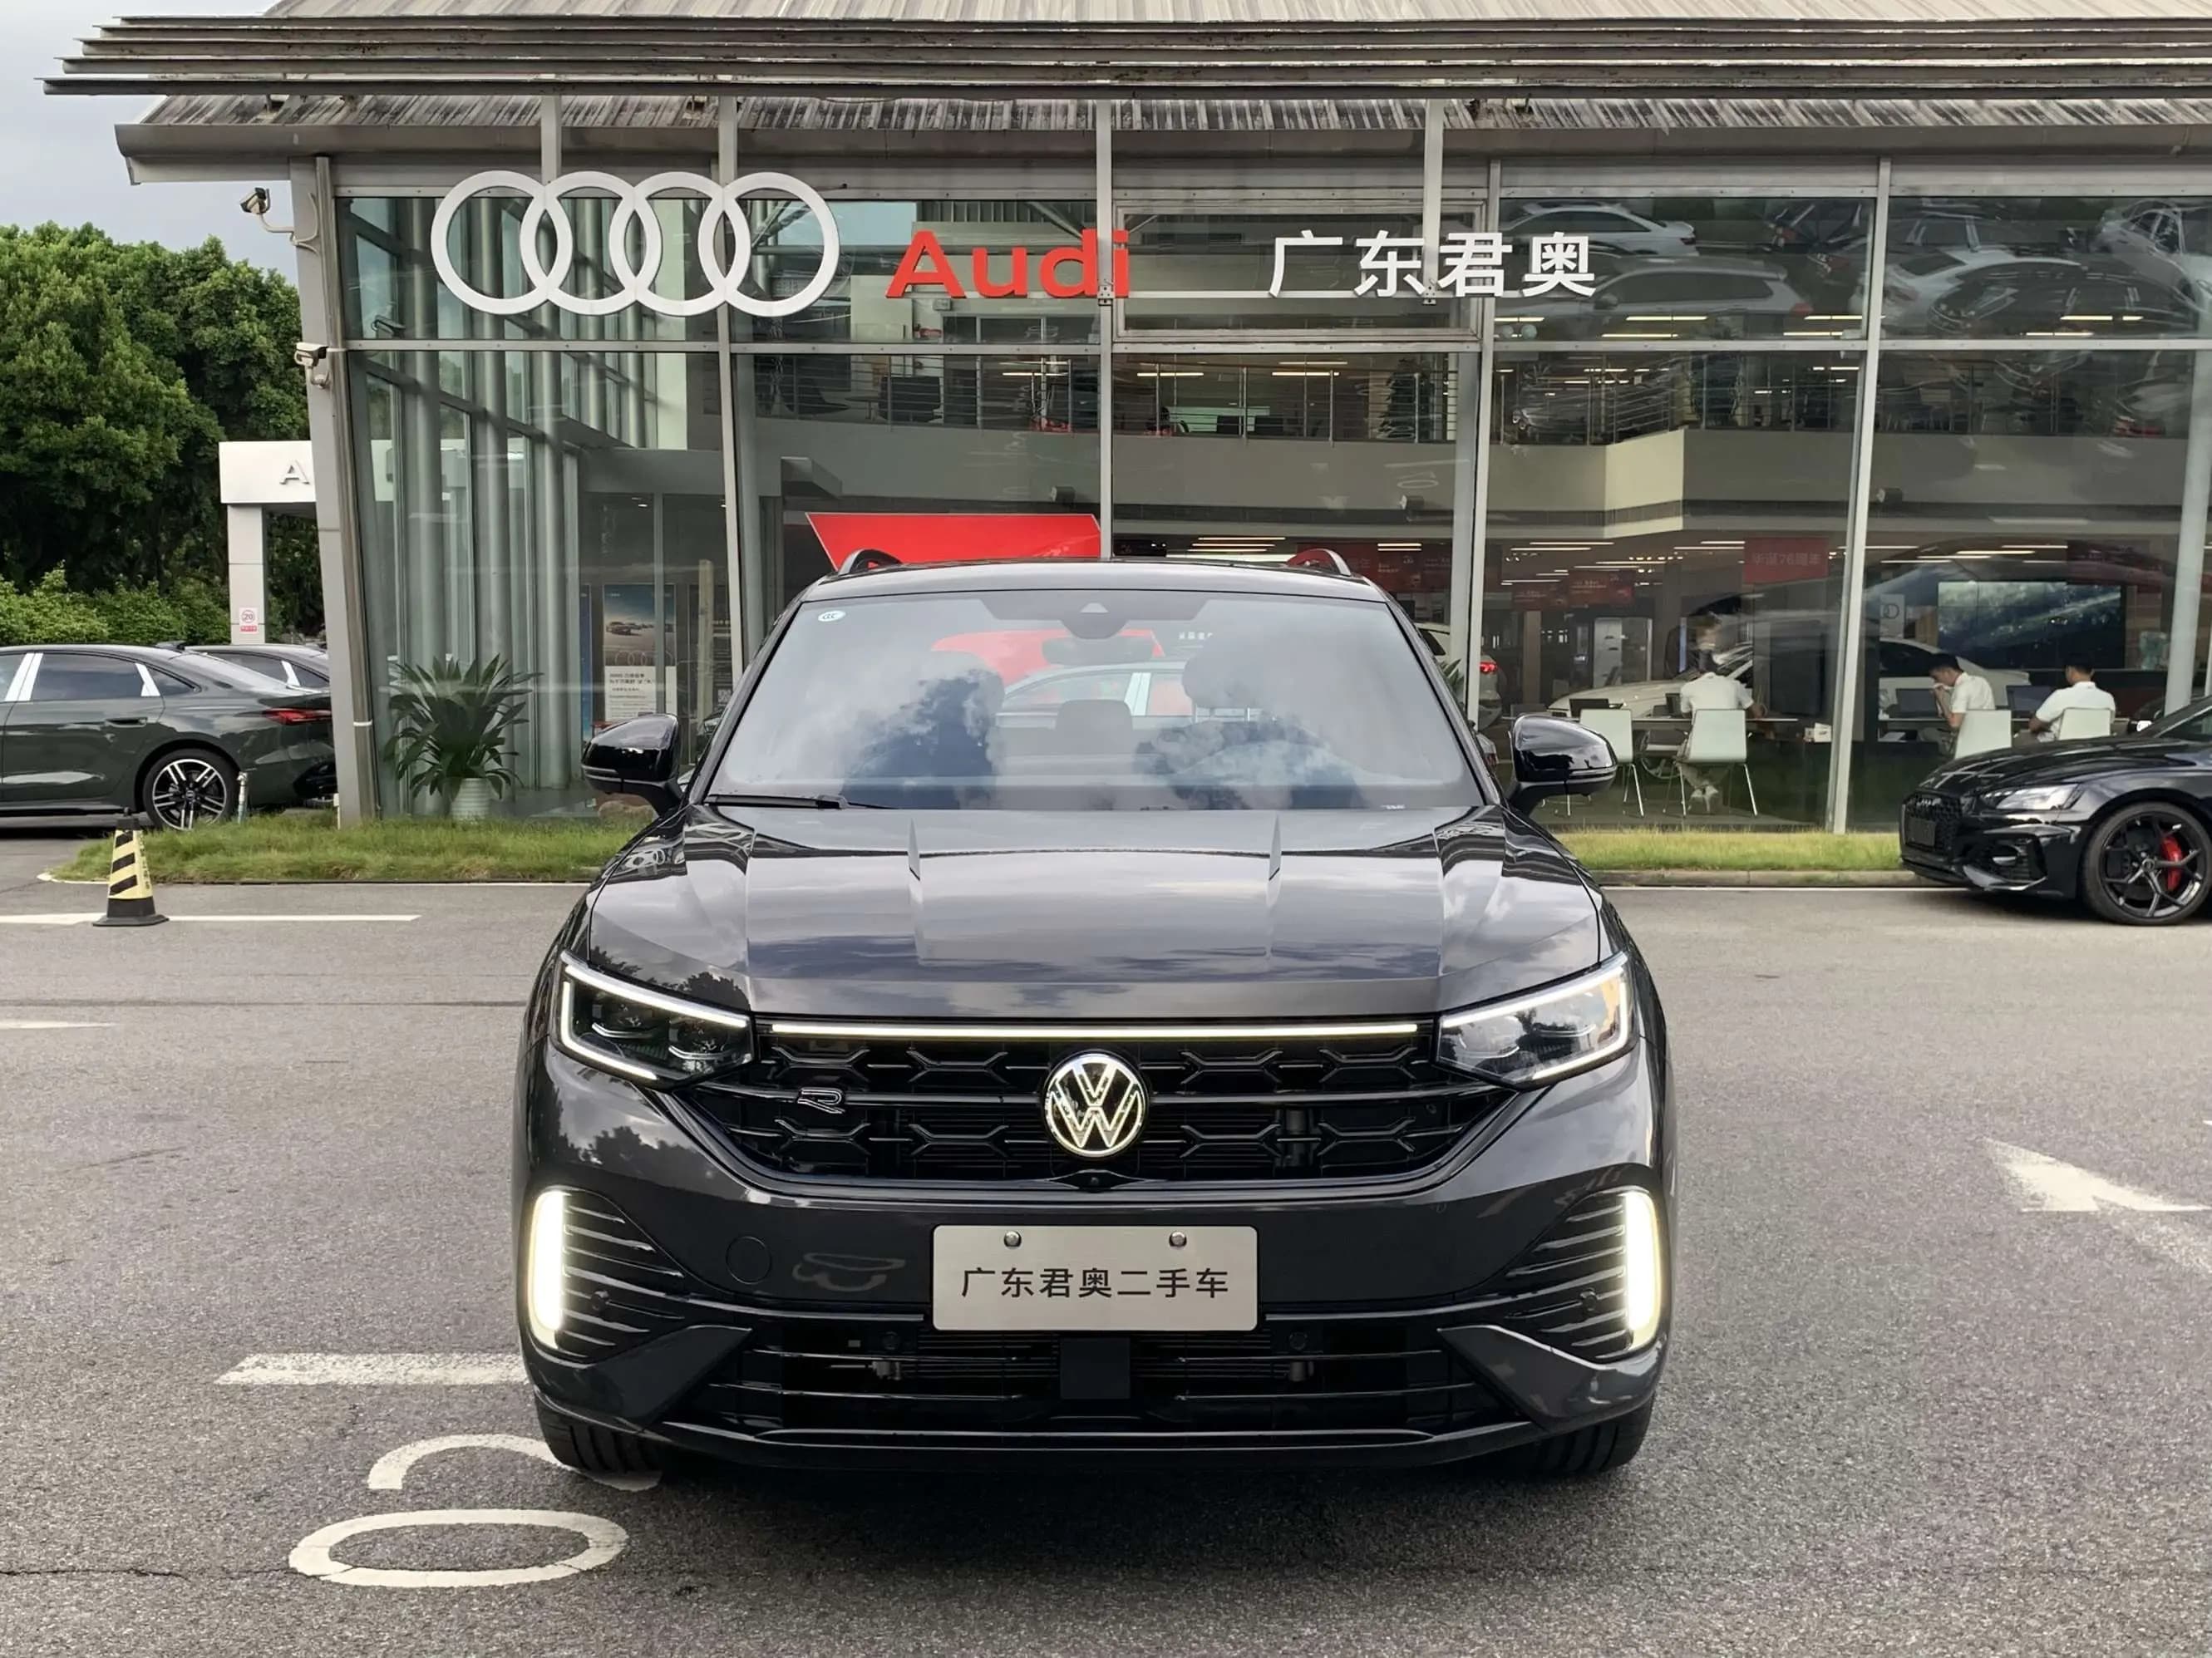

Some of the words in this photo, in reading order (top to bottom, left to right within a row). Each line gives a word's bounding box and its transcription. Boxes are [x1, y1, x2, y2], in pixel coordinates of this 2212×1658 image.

[886, 228, 1129, 298] Audi
[1269, 229, 1596, 298] 广东君奥
[961, 1267, 1229, 1298] 广东君奥二手车
